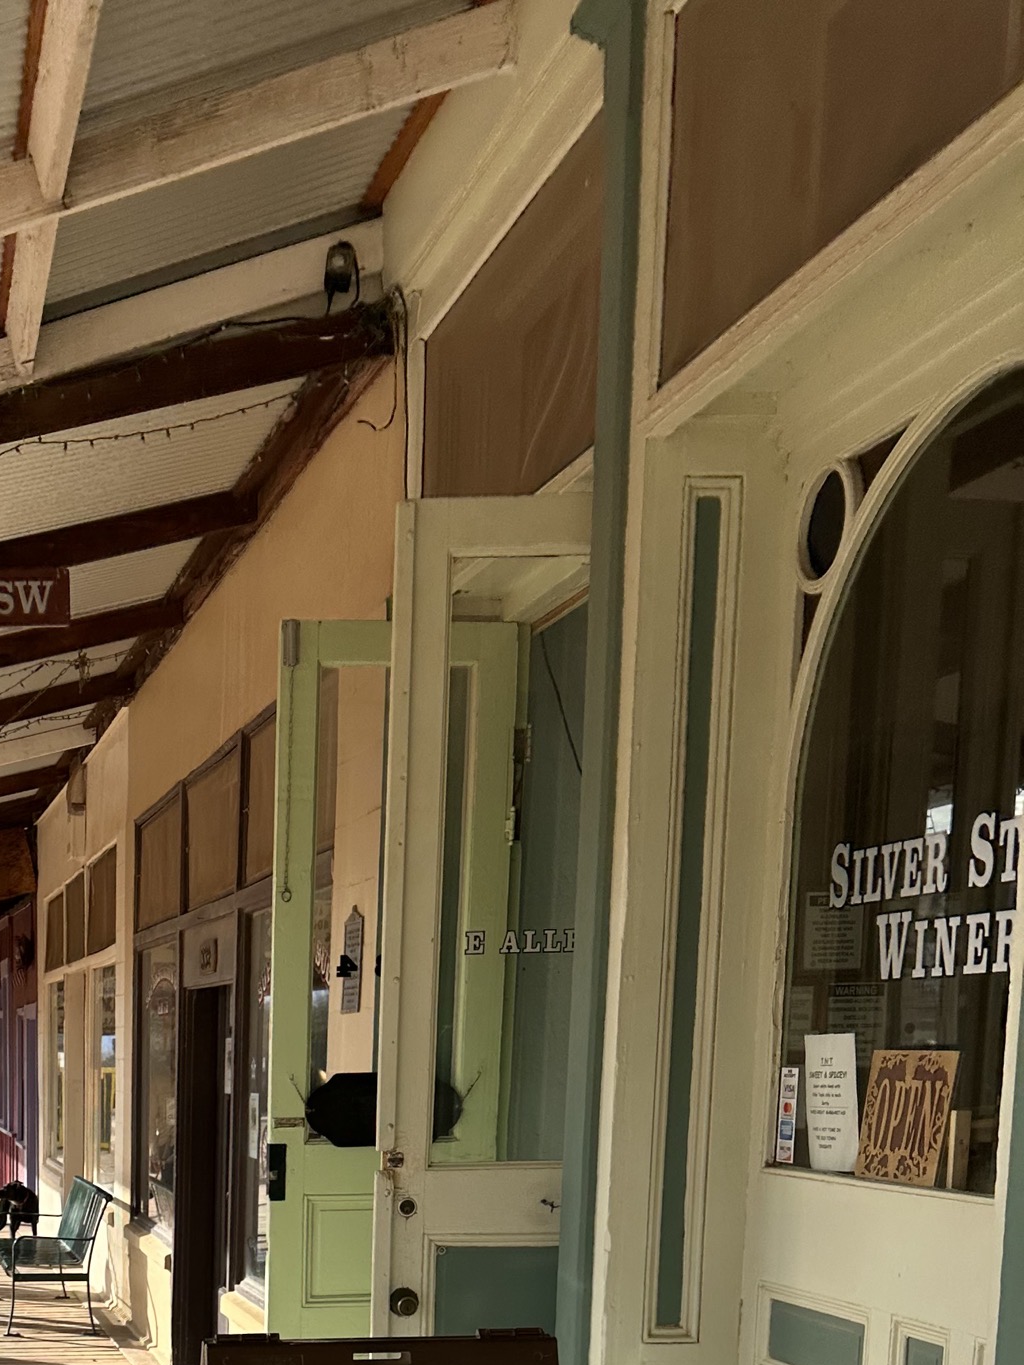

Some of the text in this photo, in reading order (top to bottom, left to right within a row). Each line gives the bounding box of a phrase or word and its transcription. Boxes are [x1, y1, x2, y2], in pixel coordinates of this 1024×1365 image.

[828, 833, 948, 909] SILVER
[464, 930, 486, 955] E
[871, 1078, 943, 1156] OPEN
